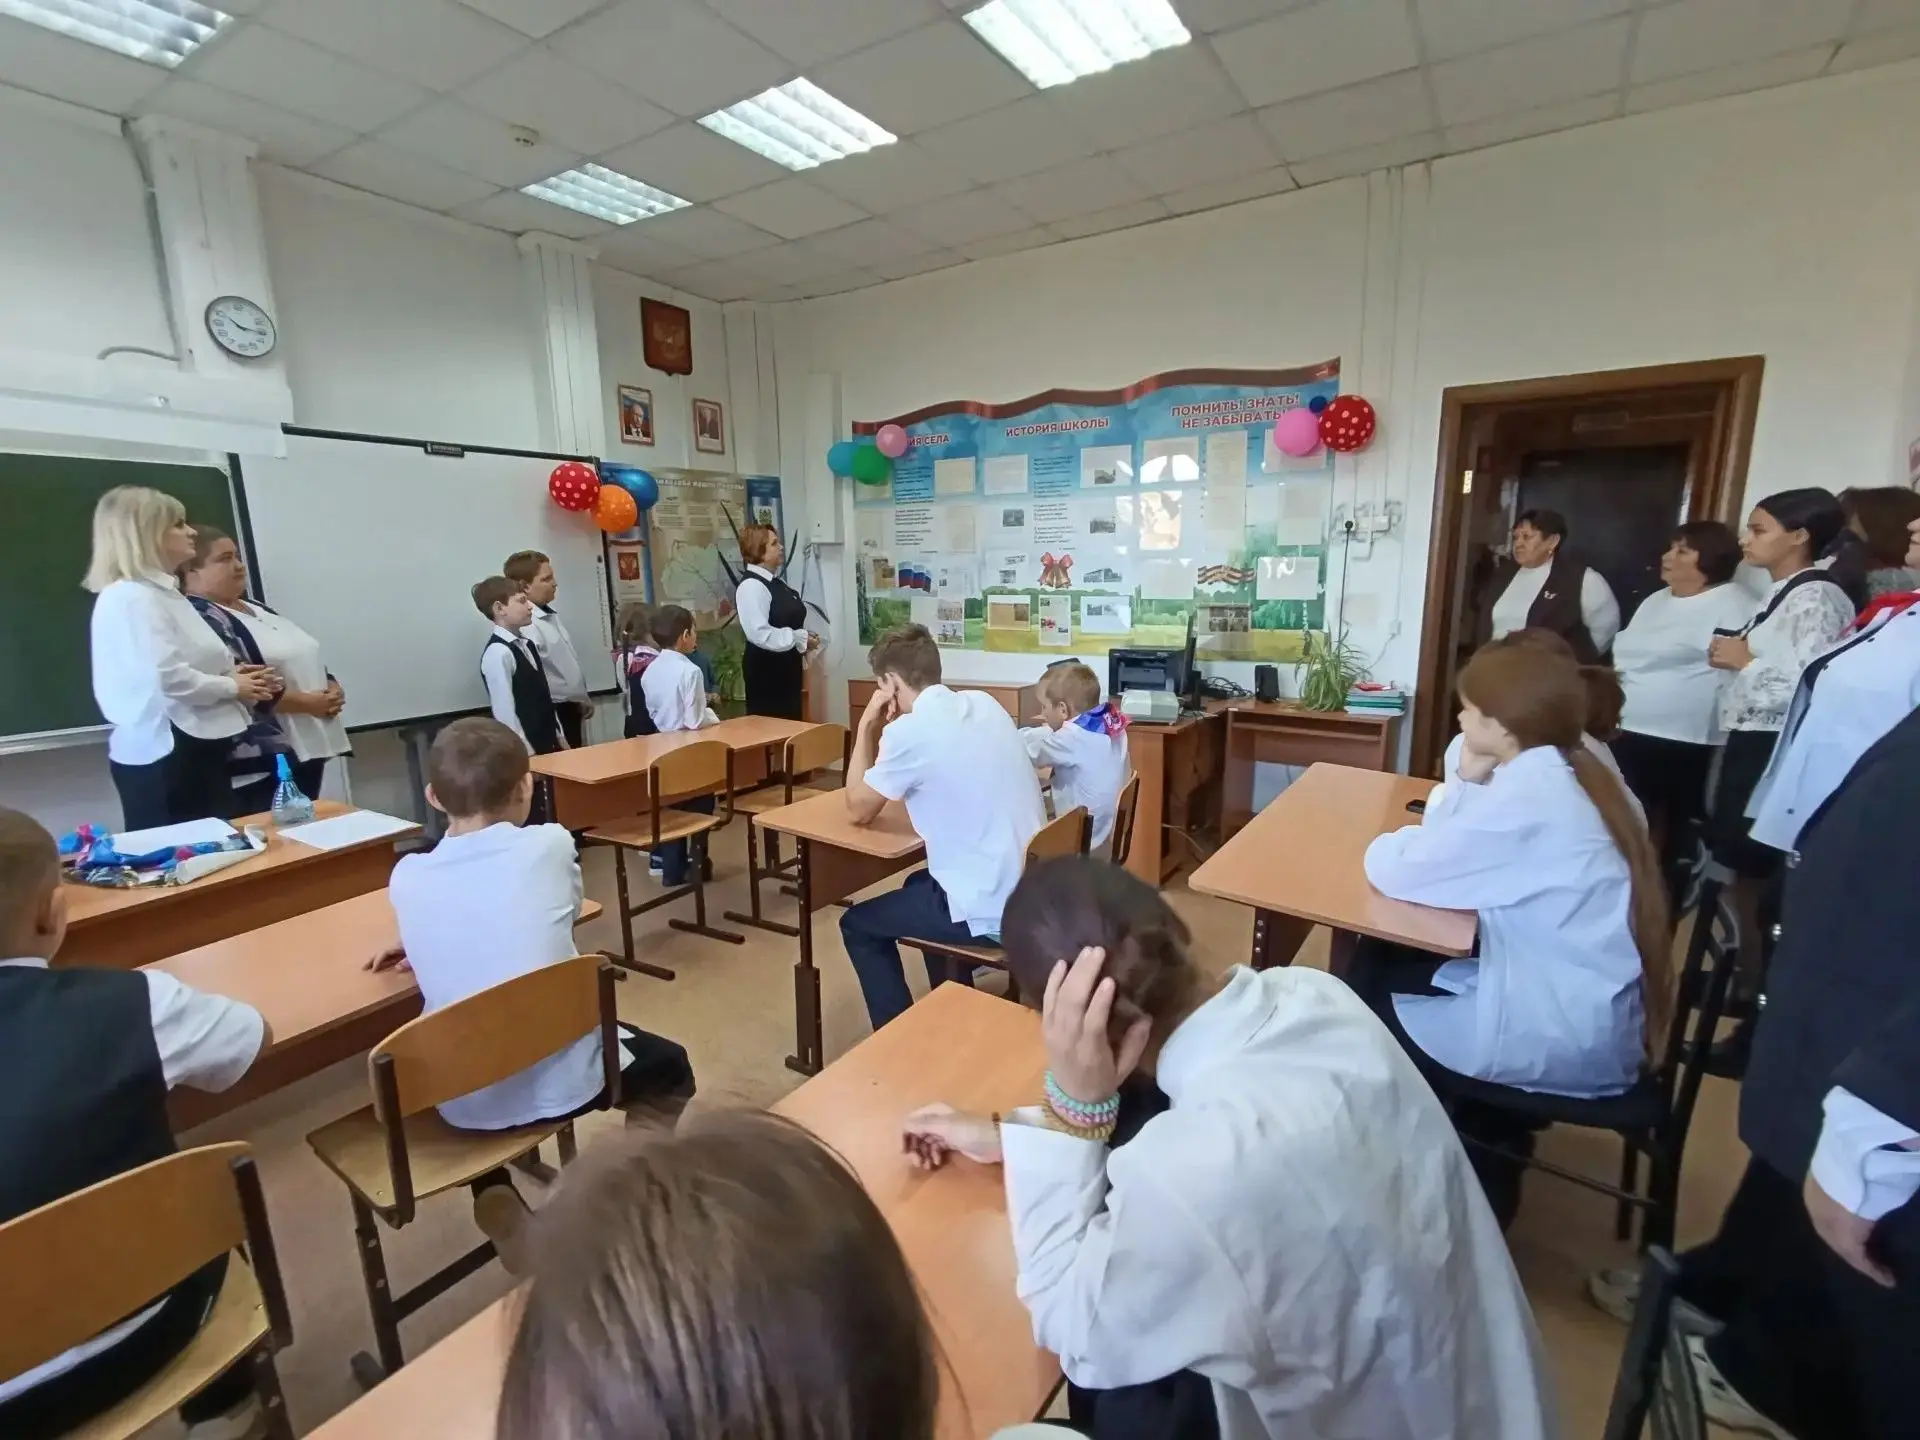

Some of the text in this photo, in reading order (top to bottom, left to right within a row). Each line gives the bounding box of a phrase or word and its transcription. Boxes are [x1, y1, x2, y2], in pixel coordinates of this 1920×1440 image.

[1171, 394, 1299, 417] ПОМНИТЬ! ЗНАТЬ!
[1006, 417, 1109, 438] ИСТОРИЯ ШКОЛЫ
[1182, 417, 1200, 429] НЕ
[924, 434, 949, 445] СЕЛА
